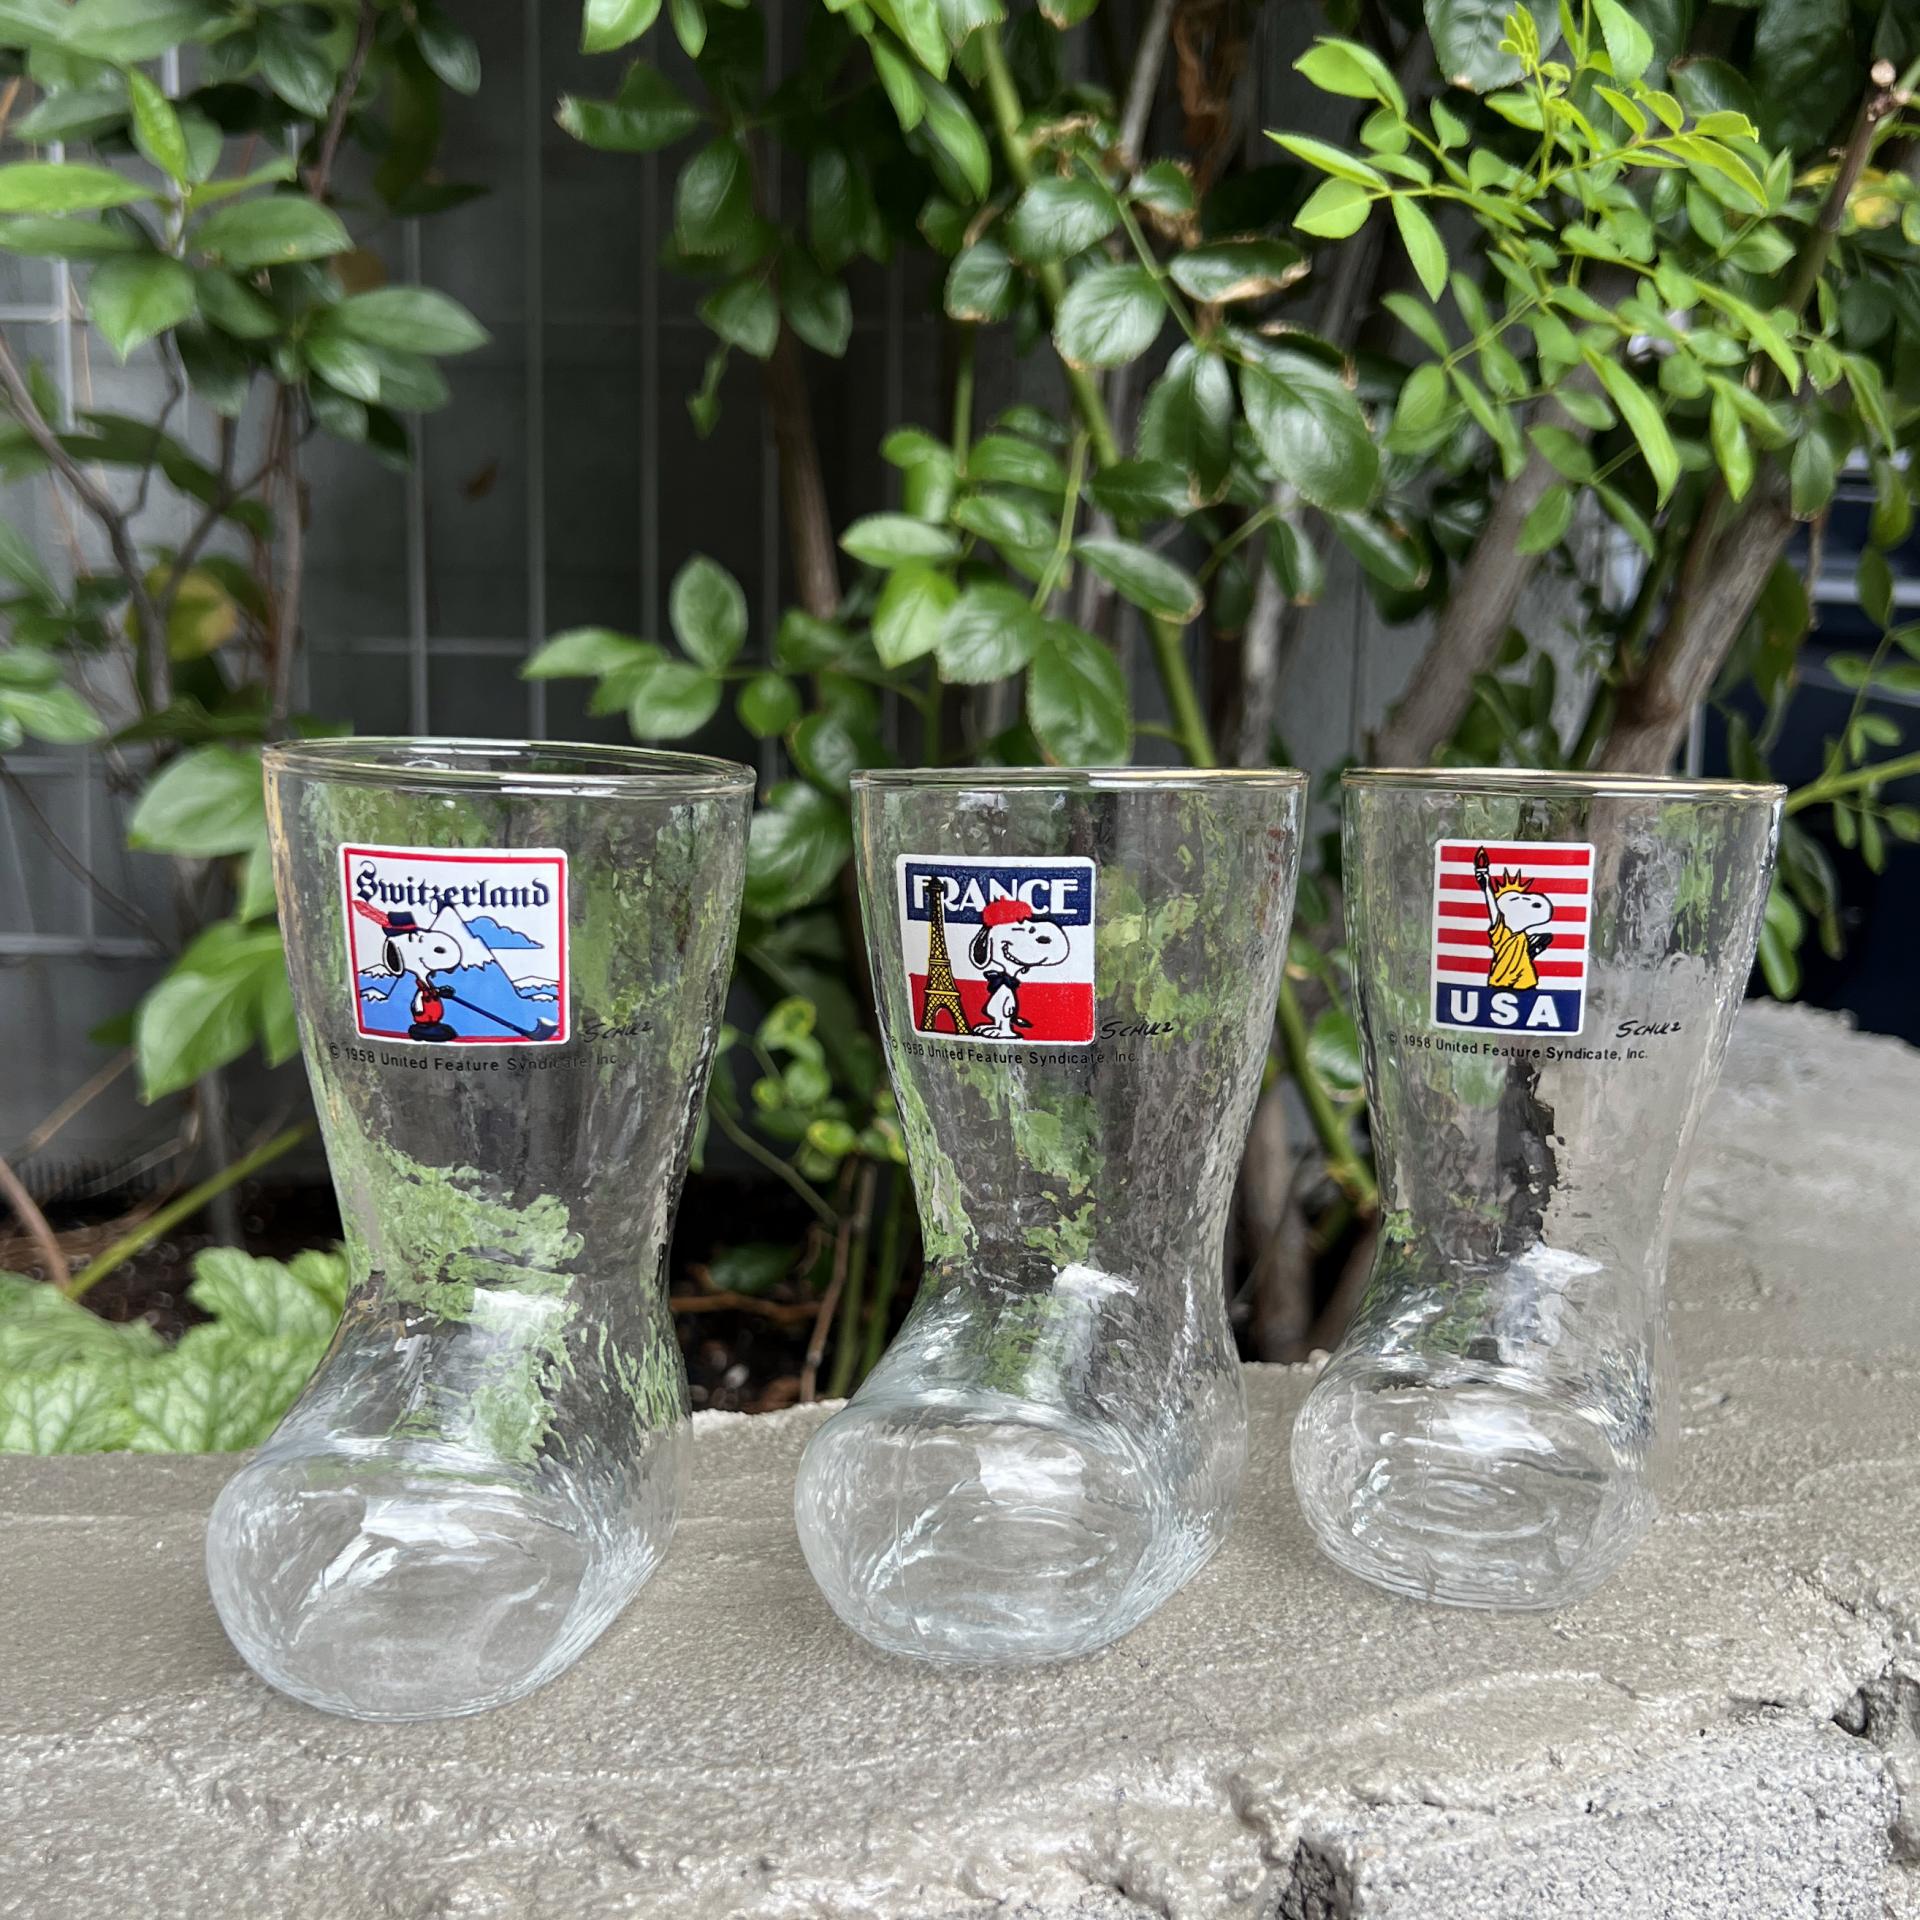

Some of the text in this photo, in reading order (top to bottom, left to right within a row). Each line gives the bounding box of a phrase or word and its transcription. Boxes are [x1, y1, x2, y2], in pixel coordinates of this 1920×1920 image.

[356, 861, 550, 914] Switzerland
[913, 874, 1078, 914] FRANCE
[1450, 989, 1561, 1028] USA
[345, 1048, 375, 1063] 1958
[380, 1053, 427, 1070] United
[435, 1058, 499, 1072] Feature
[902, 1042, 924, 1056] 1958
[928, 1044, 964, 1061] United
[968, 1049, 1023, 1064] Feature
[1404, 1034, 1431, 1049] 1958
[1436, 1039, 1478, 1055] United
[1483, 1044, 1541, 1059] Feature
[1546, 1047, 1622, 1062] Syndicate,
[1626, 1047, 1649, 1060] Inc.
